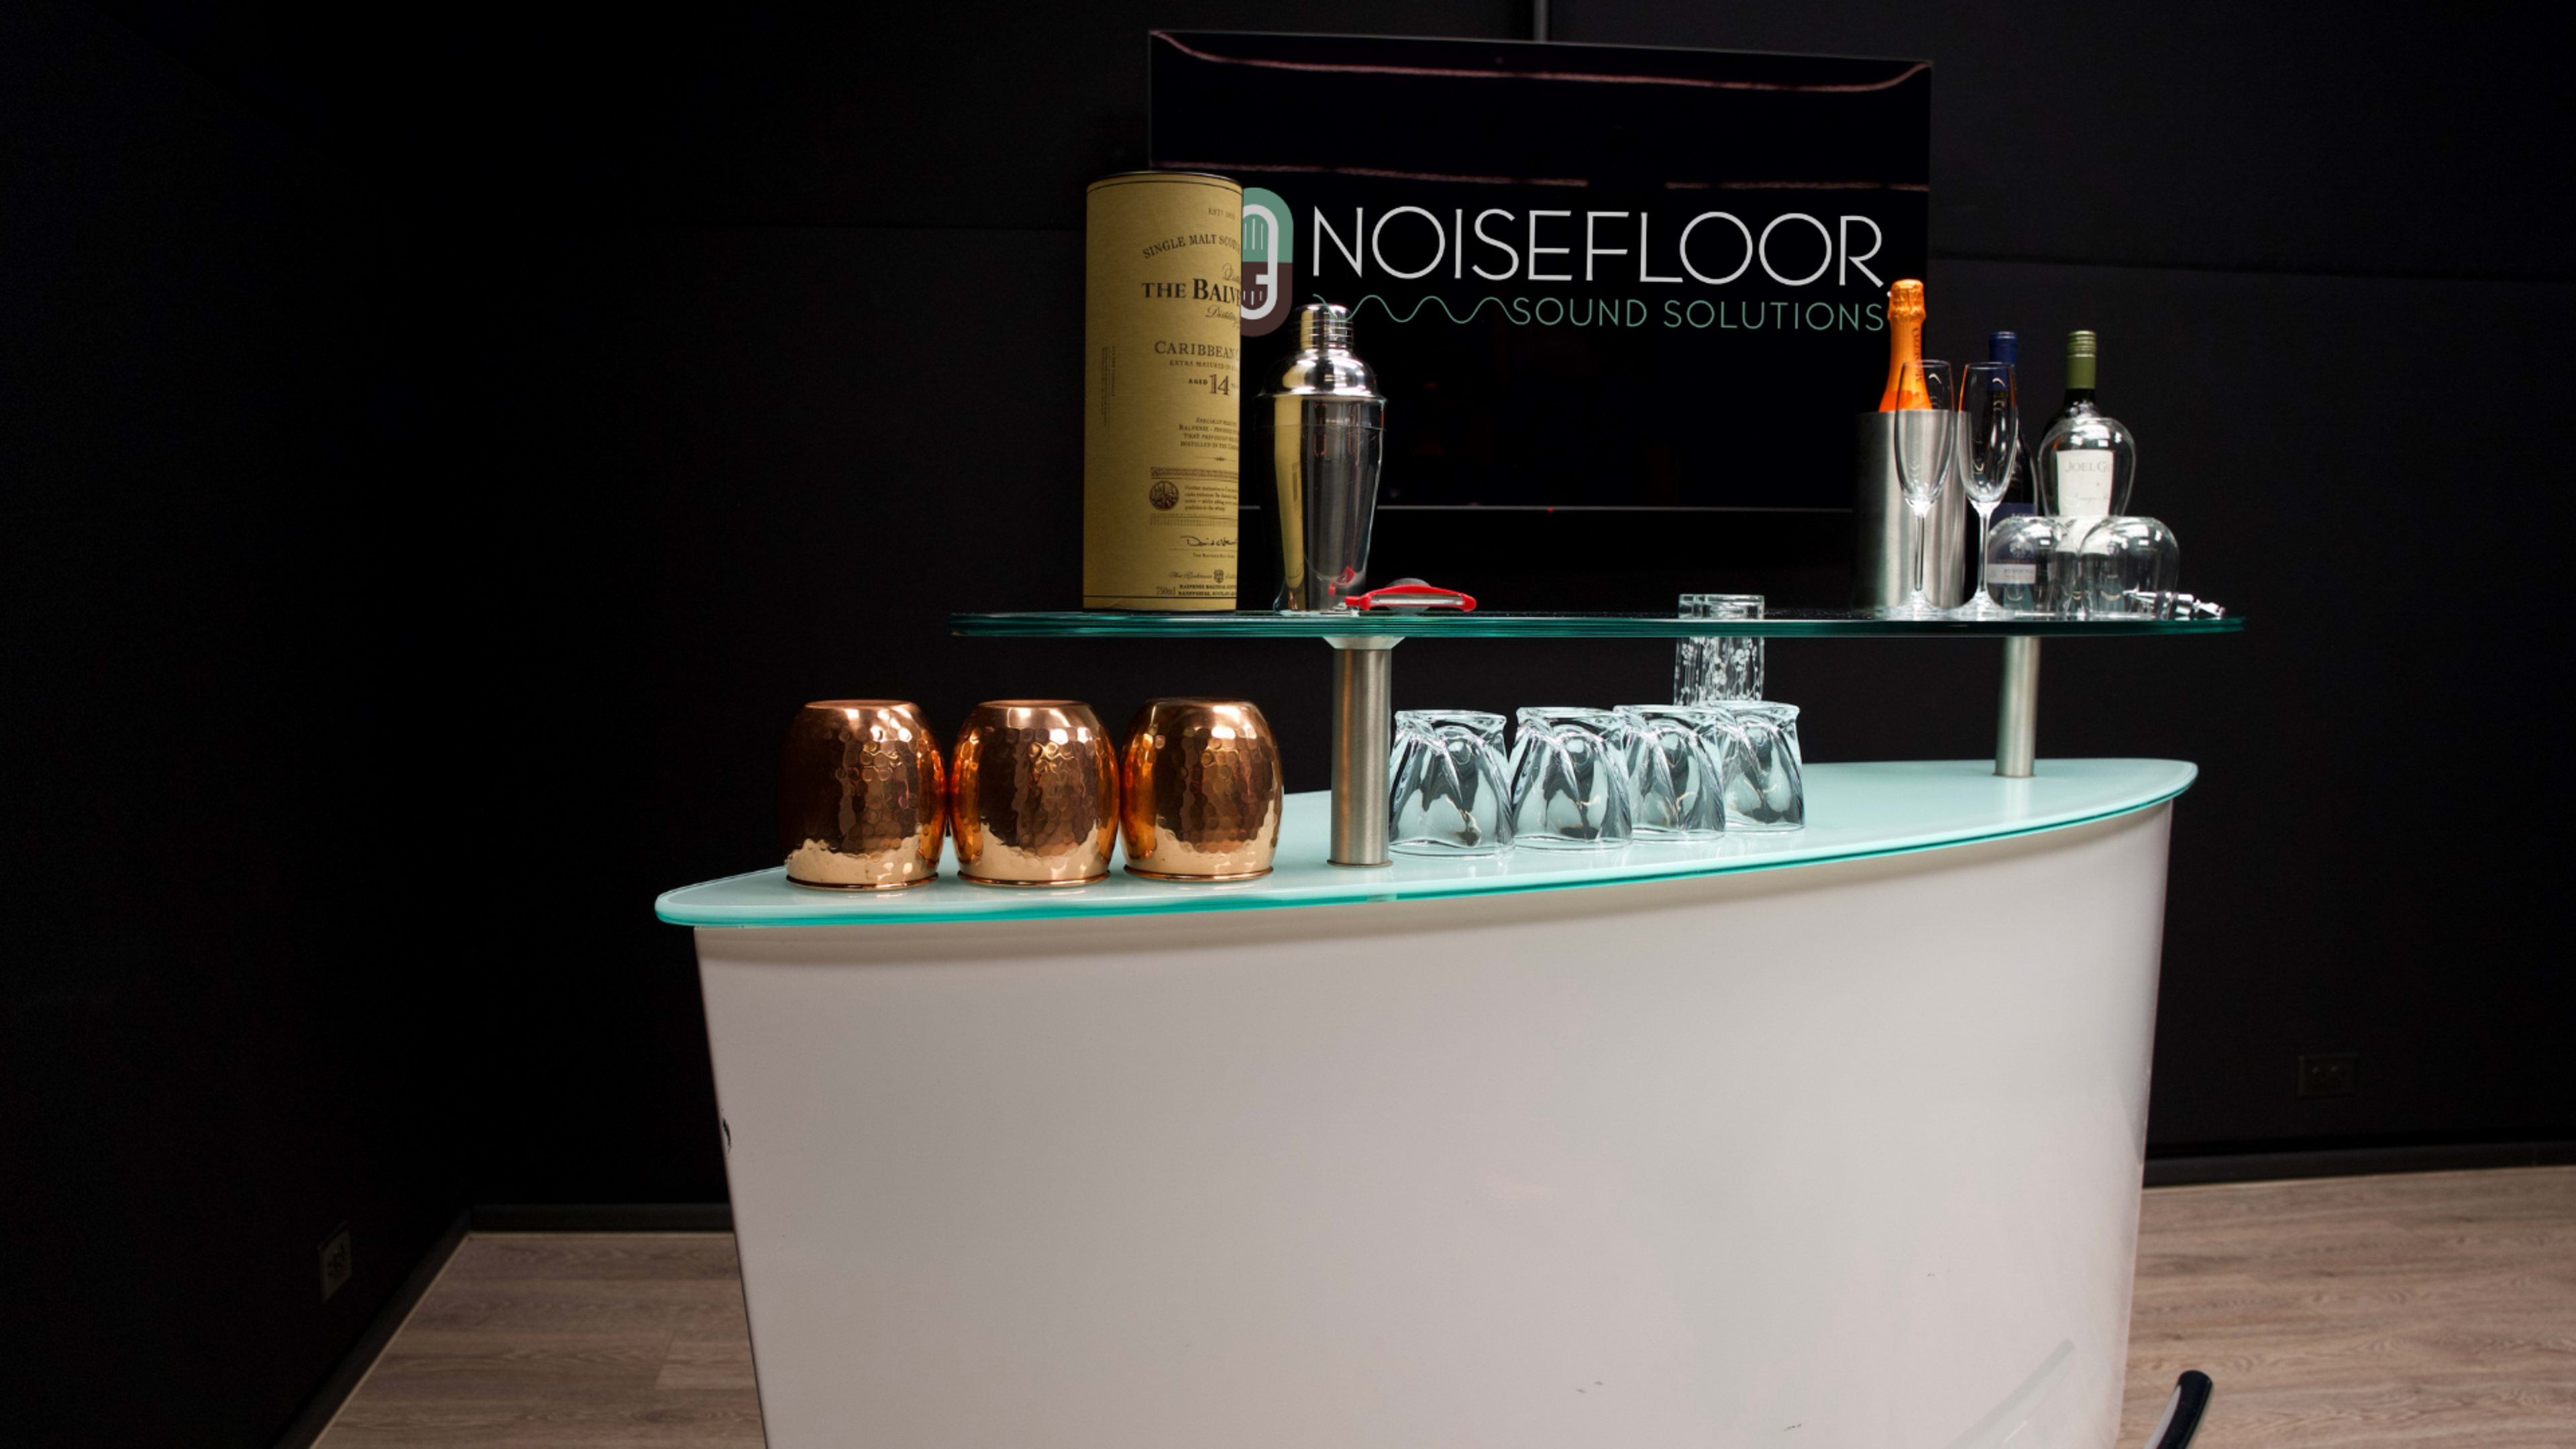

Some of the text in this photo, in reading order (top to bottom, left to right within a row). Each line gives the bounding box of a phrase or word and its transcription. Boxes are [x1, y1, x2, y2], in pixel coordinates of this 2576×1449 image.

[1142, 236, 1185, 260] SINGLE
[1189, 233, 1216, 246] MALT
[1313, 206, 1884, 288] NOISEFLOOR
[1142, 282, 1186, 299] THE
[1513, 297, 1884, 332] SOUND SOLUTIONS
[1210, 373, 1229, 396] 14
[2065, 461, 2095, 473] JOEL
